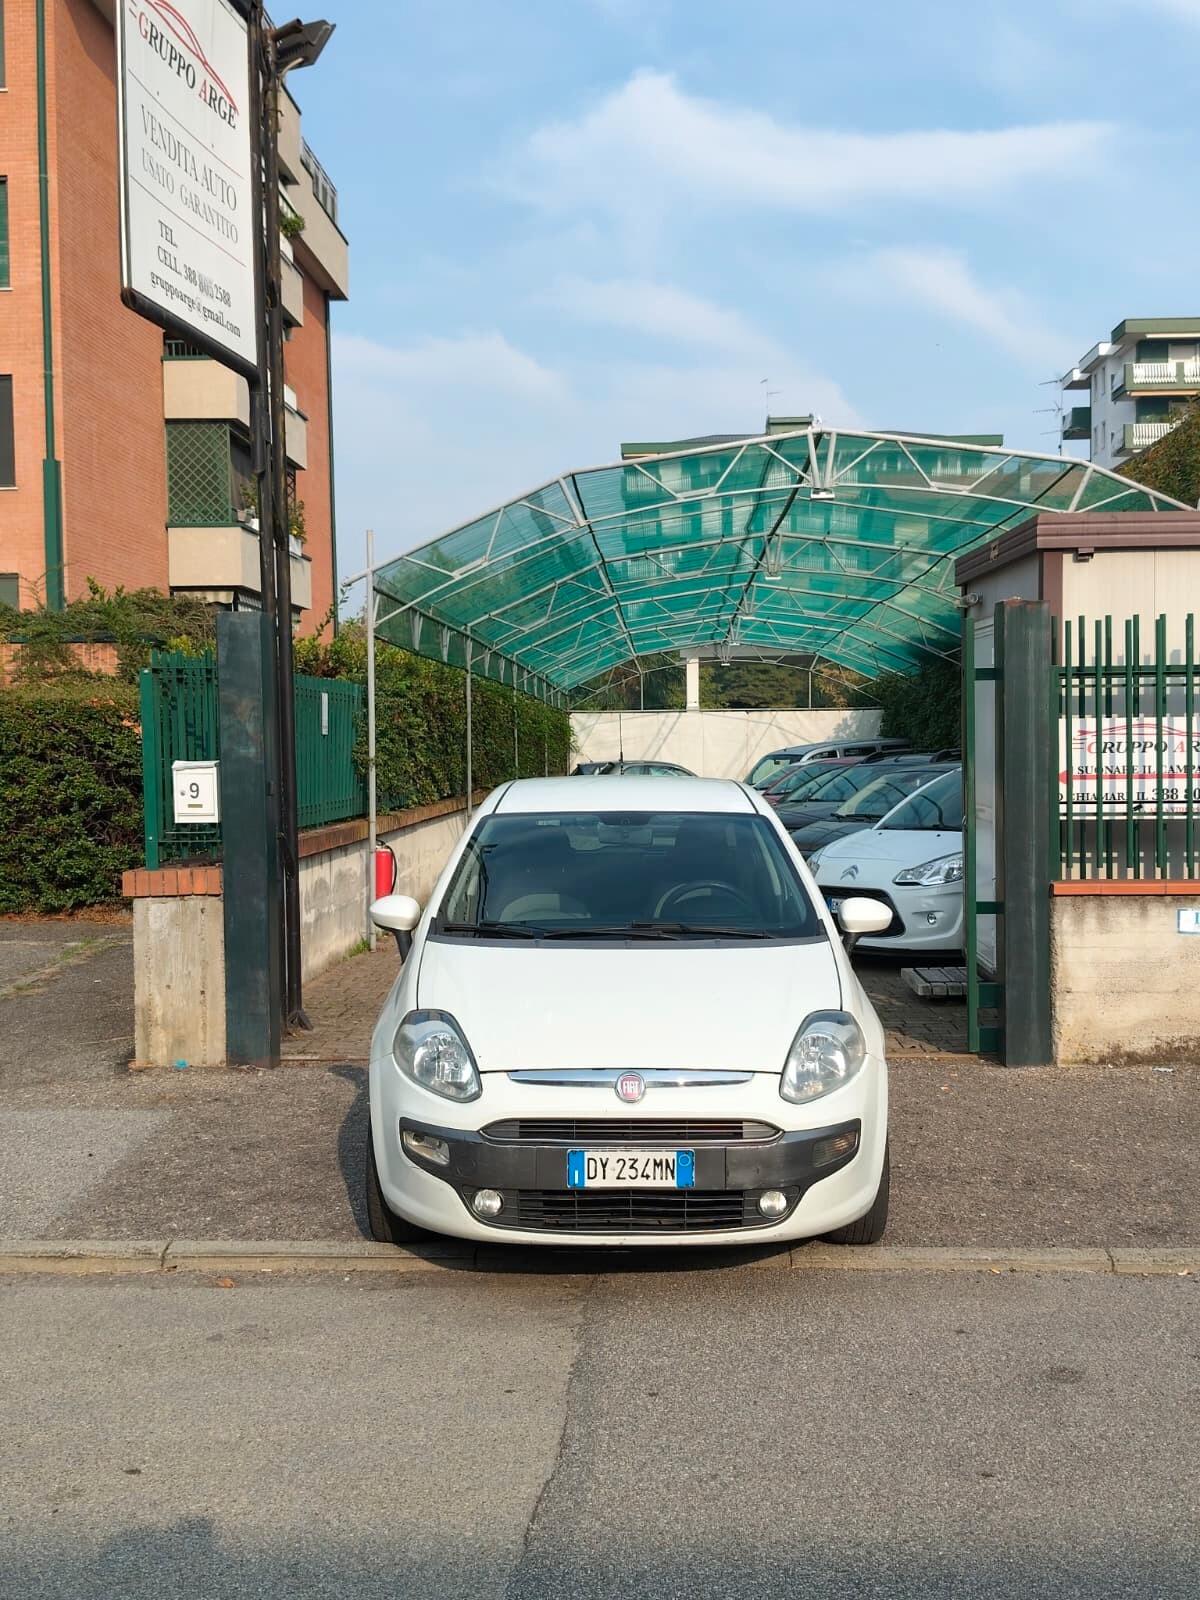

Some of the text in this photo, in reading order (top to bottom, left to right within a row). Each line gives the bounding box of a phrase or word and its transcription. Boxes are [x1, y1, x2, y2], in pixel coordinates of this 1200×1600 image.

[139, 11, 237, 129] GRUPPO ARGE
[141, 103, 237, 211] VENDITA AUTO
[142, 147, 239, 243] USATO GARANTITO
[183, 263, 198, 286] 388
[213, 283, 231, 307] 2588
[189, 782, 200, 799] 9
[622, 1080, 640, 1094] FIAT
[587, 1157, 609, 1181] DY
[615, 1157, 676, 1181] 234MN
